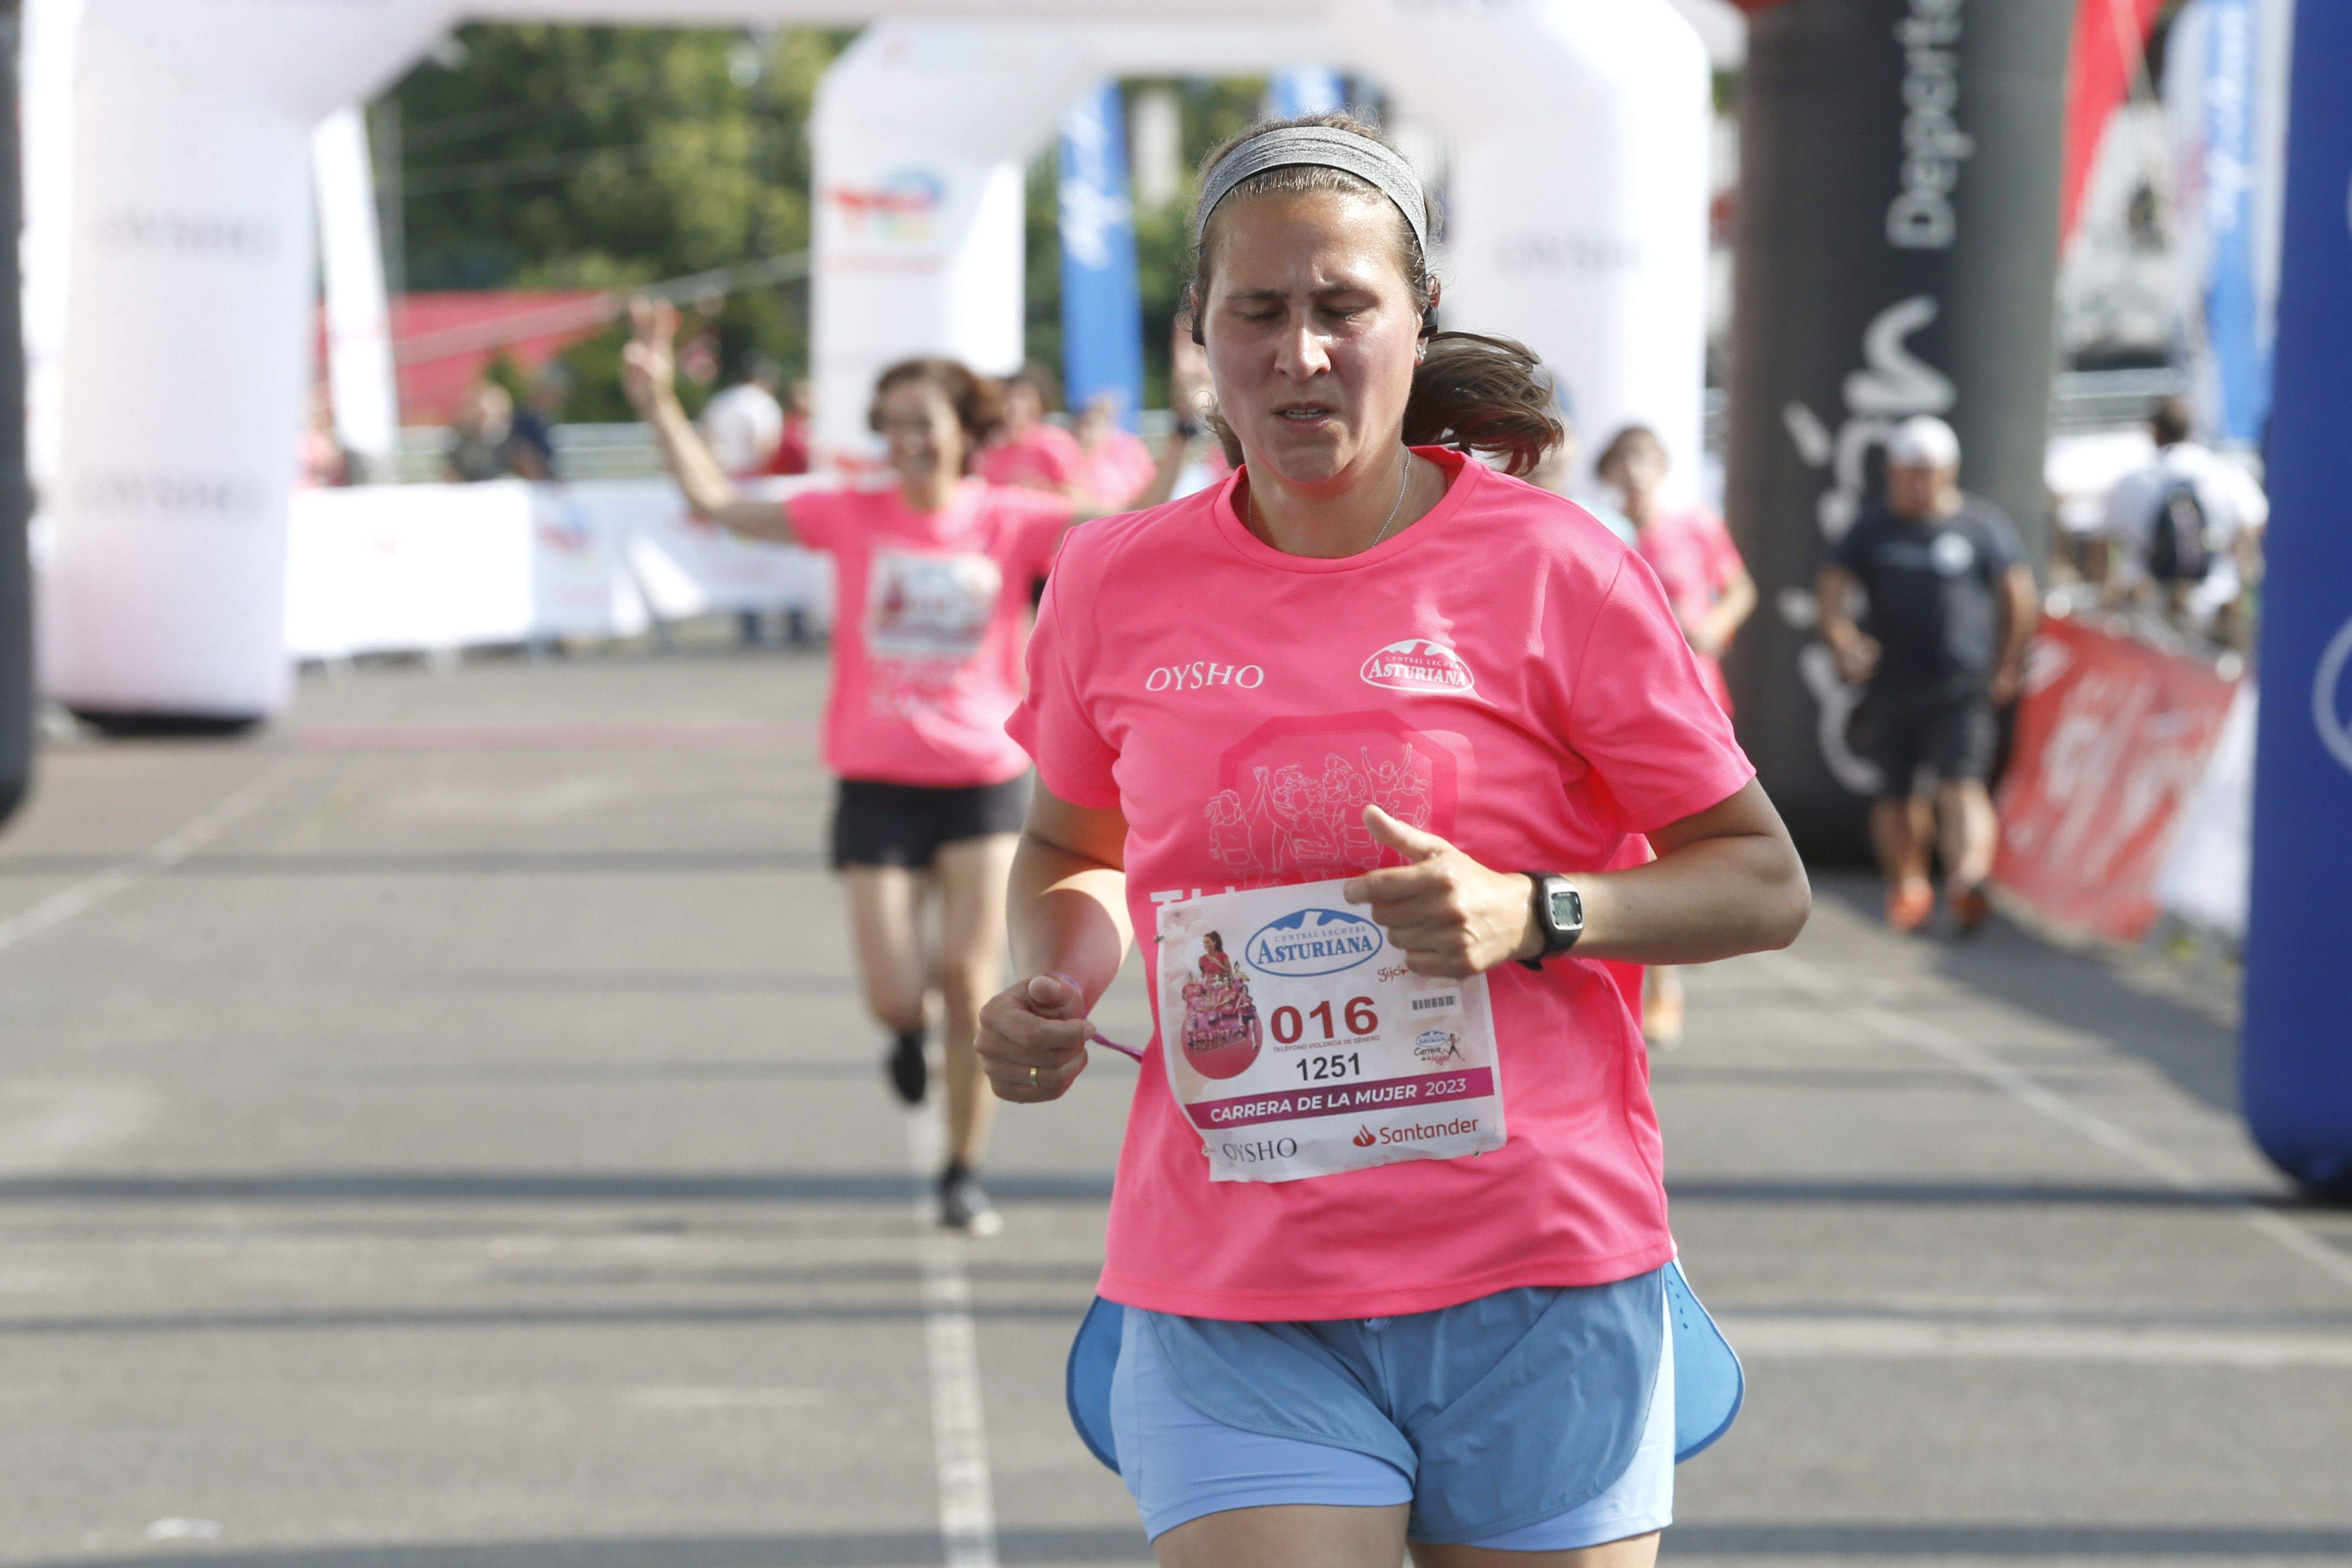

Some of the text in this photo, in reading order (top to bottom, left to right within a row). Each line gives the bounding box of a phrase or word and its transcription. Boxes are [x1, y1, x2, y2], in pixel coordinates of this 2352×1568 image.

[1368, 659, 1467, 685] ASTURIANA
[1386, 655, 1424, 664] CENTRAL
[1146, 661, 1264, 691] OYSHO
[1275, 926, 1367, 942] CENTRAL LECHERA
[1257, 935, 1373, 964] ASTURIANA
[1271, 996, 1378, 1044] 016
[1309, 1040, 1342, 1049] VIOLENCIA
[1296, 1053, 1359, 1080] 1251
[1210, 1078, 1466, 1122] CARRERA DE LA MUJER 2023
[1380, 1118, 1479, 1145] Santander
[1223, 1138, 1297, 1163] OYSHO
